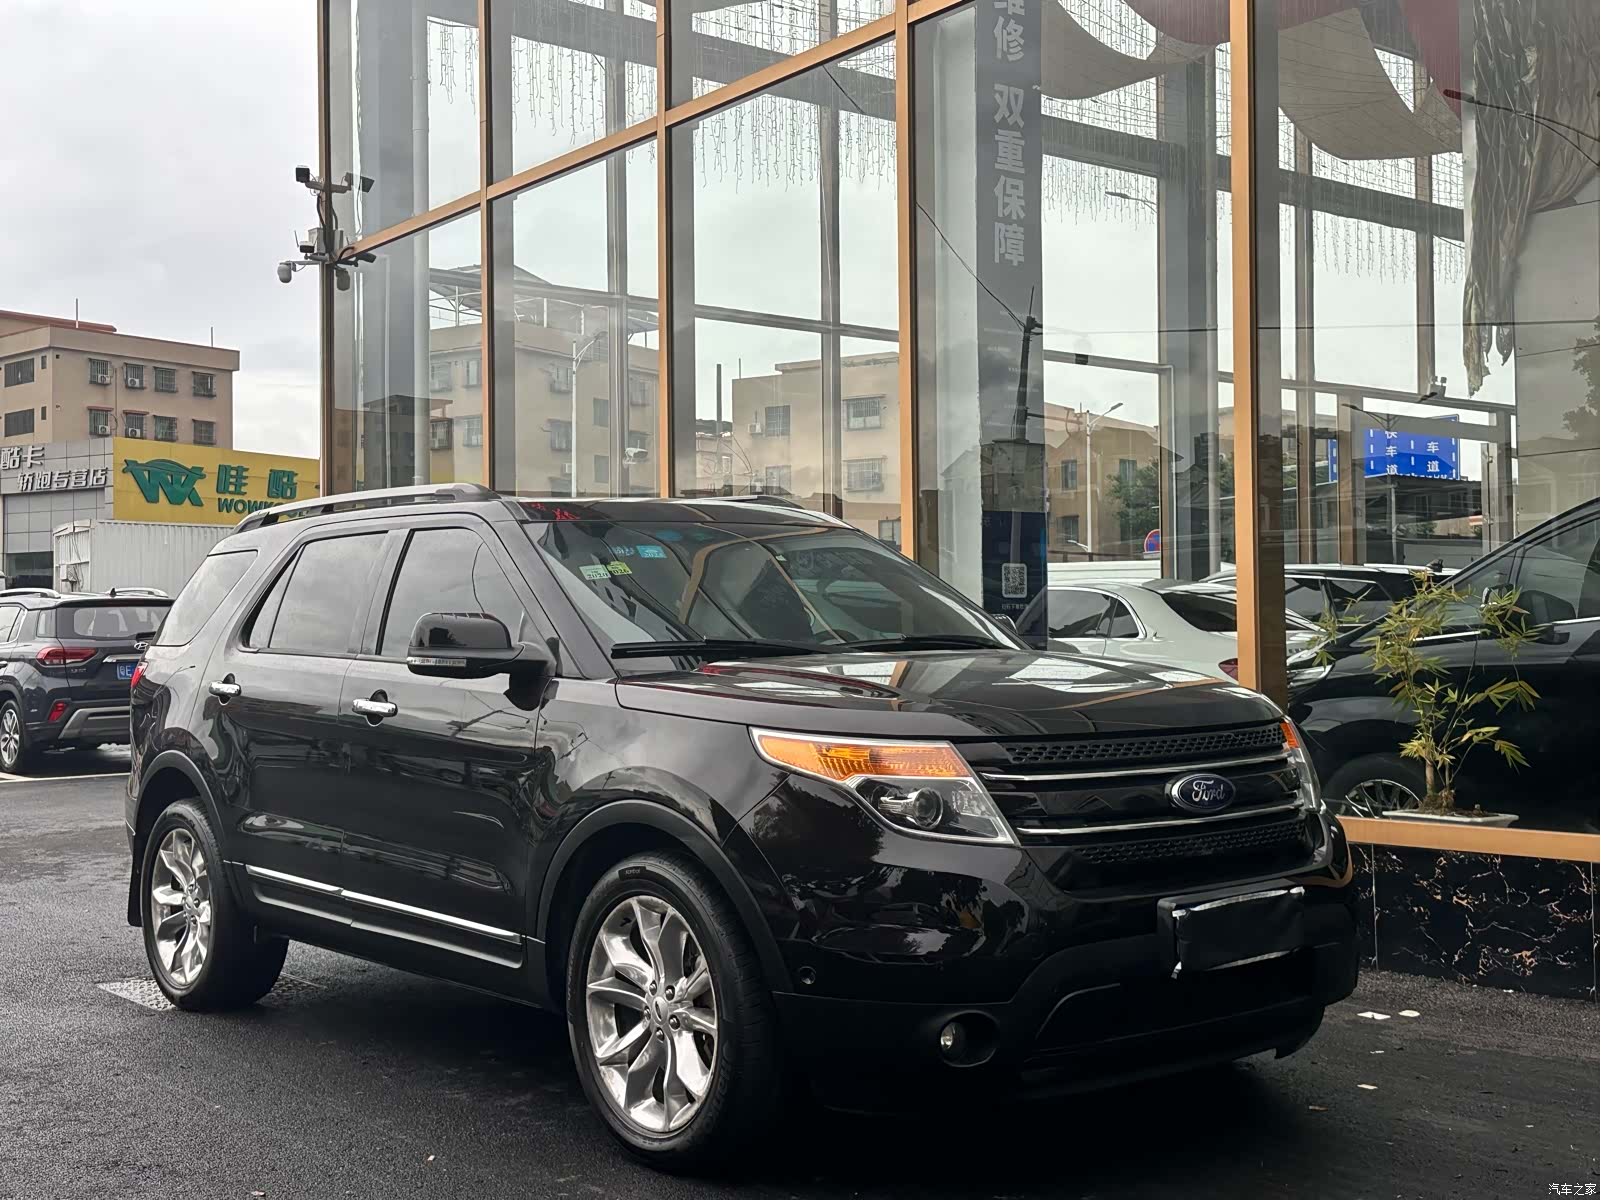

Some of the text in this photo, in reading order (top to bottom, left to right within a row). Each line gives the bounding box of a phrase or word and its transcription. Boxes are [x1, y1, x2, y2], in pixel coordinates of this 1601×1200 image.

[993, 83, 1026, 266] 双重保障
[1192, 780, 1226, 801] Ford
